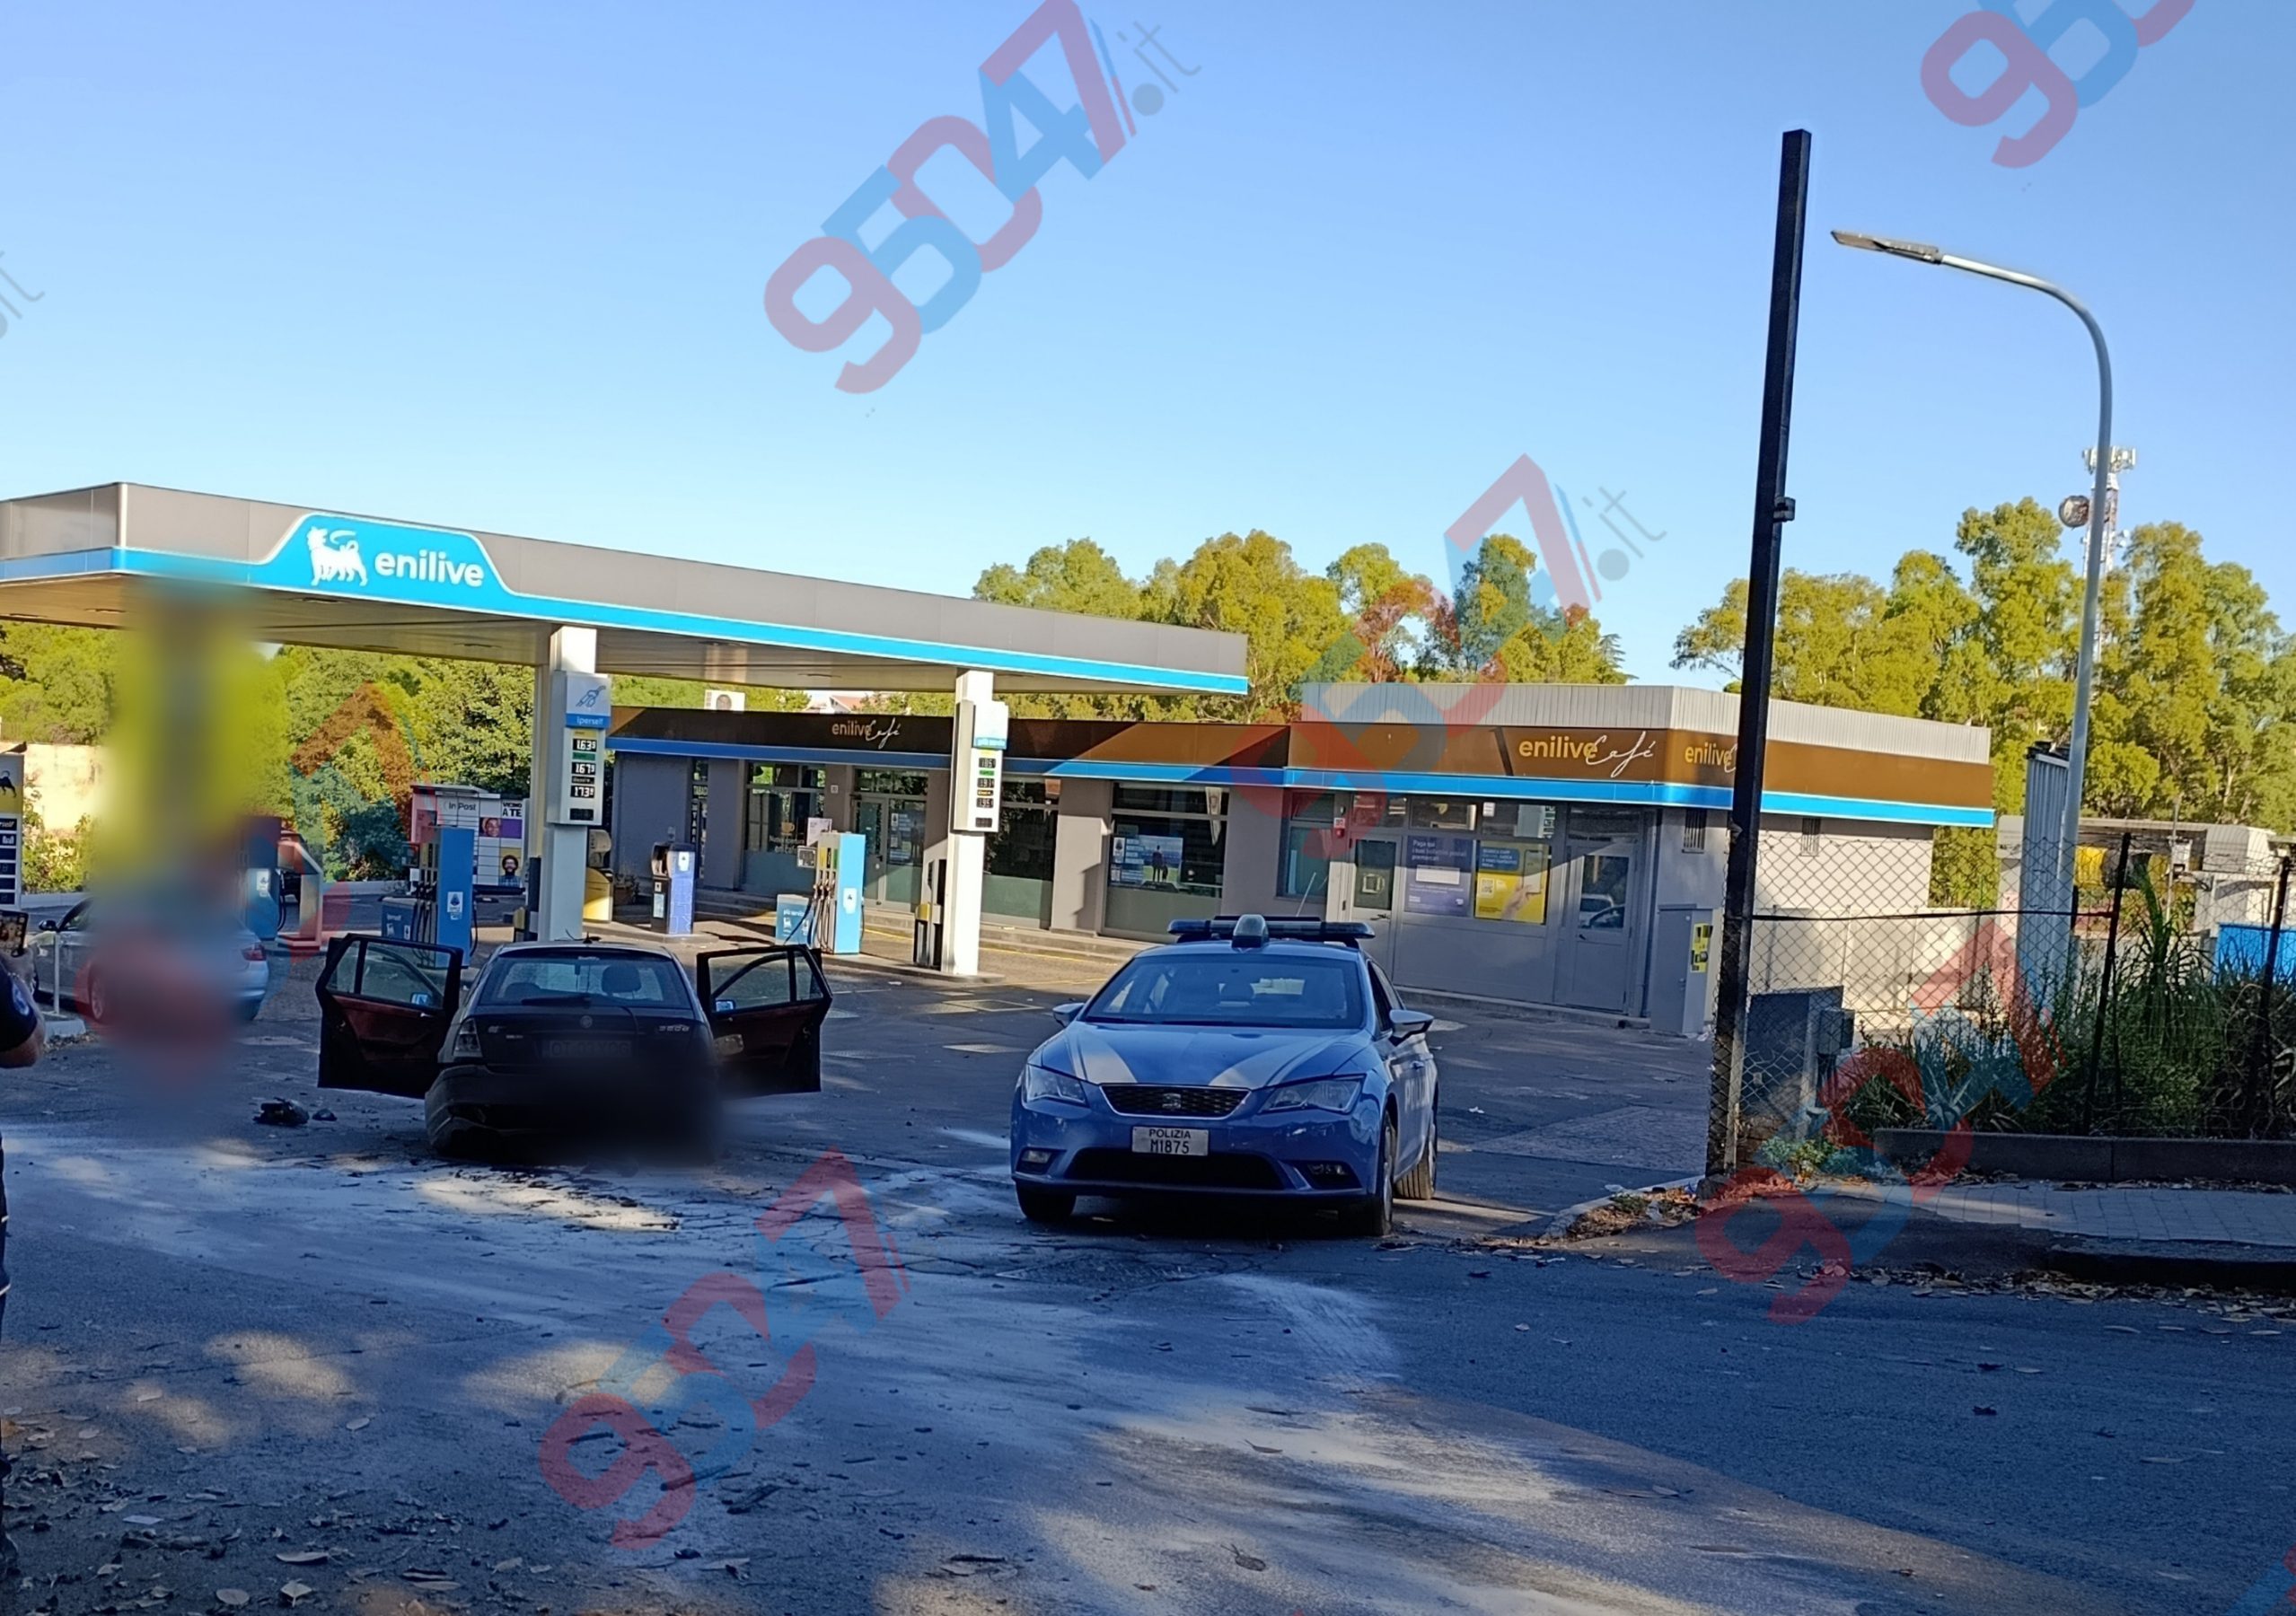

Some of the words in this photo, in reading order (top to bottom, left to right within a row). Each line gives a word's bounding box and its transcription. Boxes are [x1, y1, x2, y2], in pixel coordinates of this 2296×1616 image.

[374, 549, 484, 587] enilive
[831, 720, 872, 736] enilive
[1518, 735, 1598, 759] enilive
[1586, 731, 1656, 778] Café
[1685, 742, 1732, 767] enilive
[510, 809, 523, 818] TE
[1149, 1129, 1192, 1139] POLIZIA
[1150, 1139, 1190, 1155] M1875
